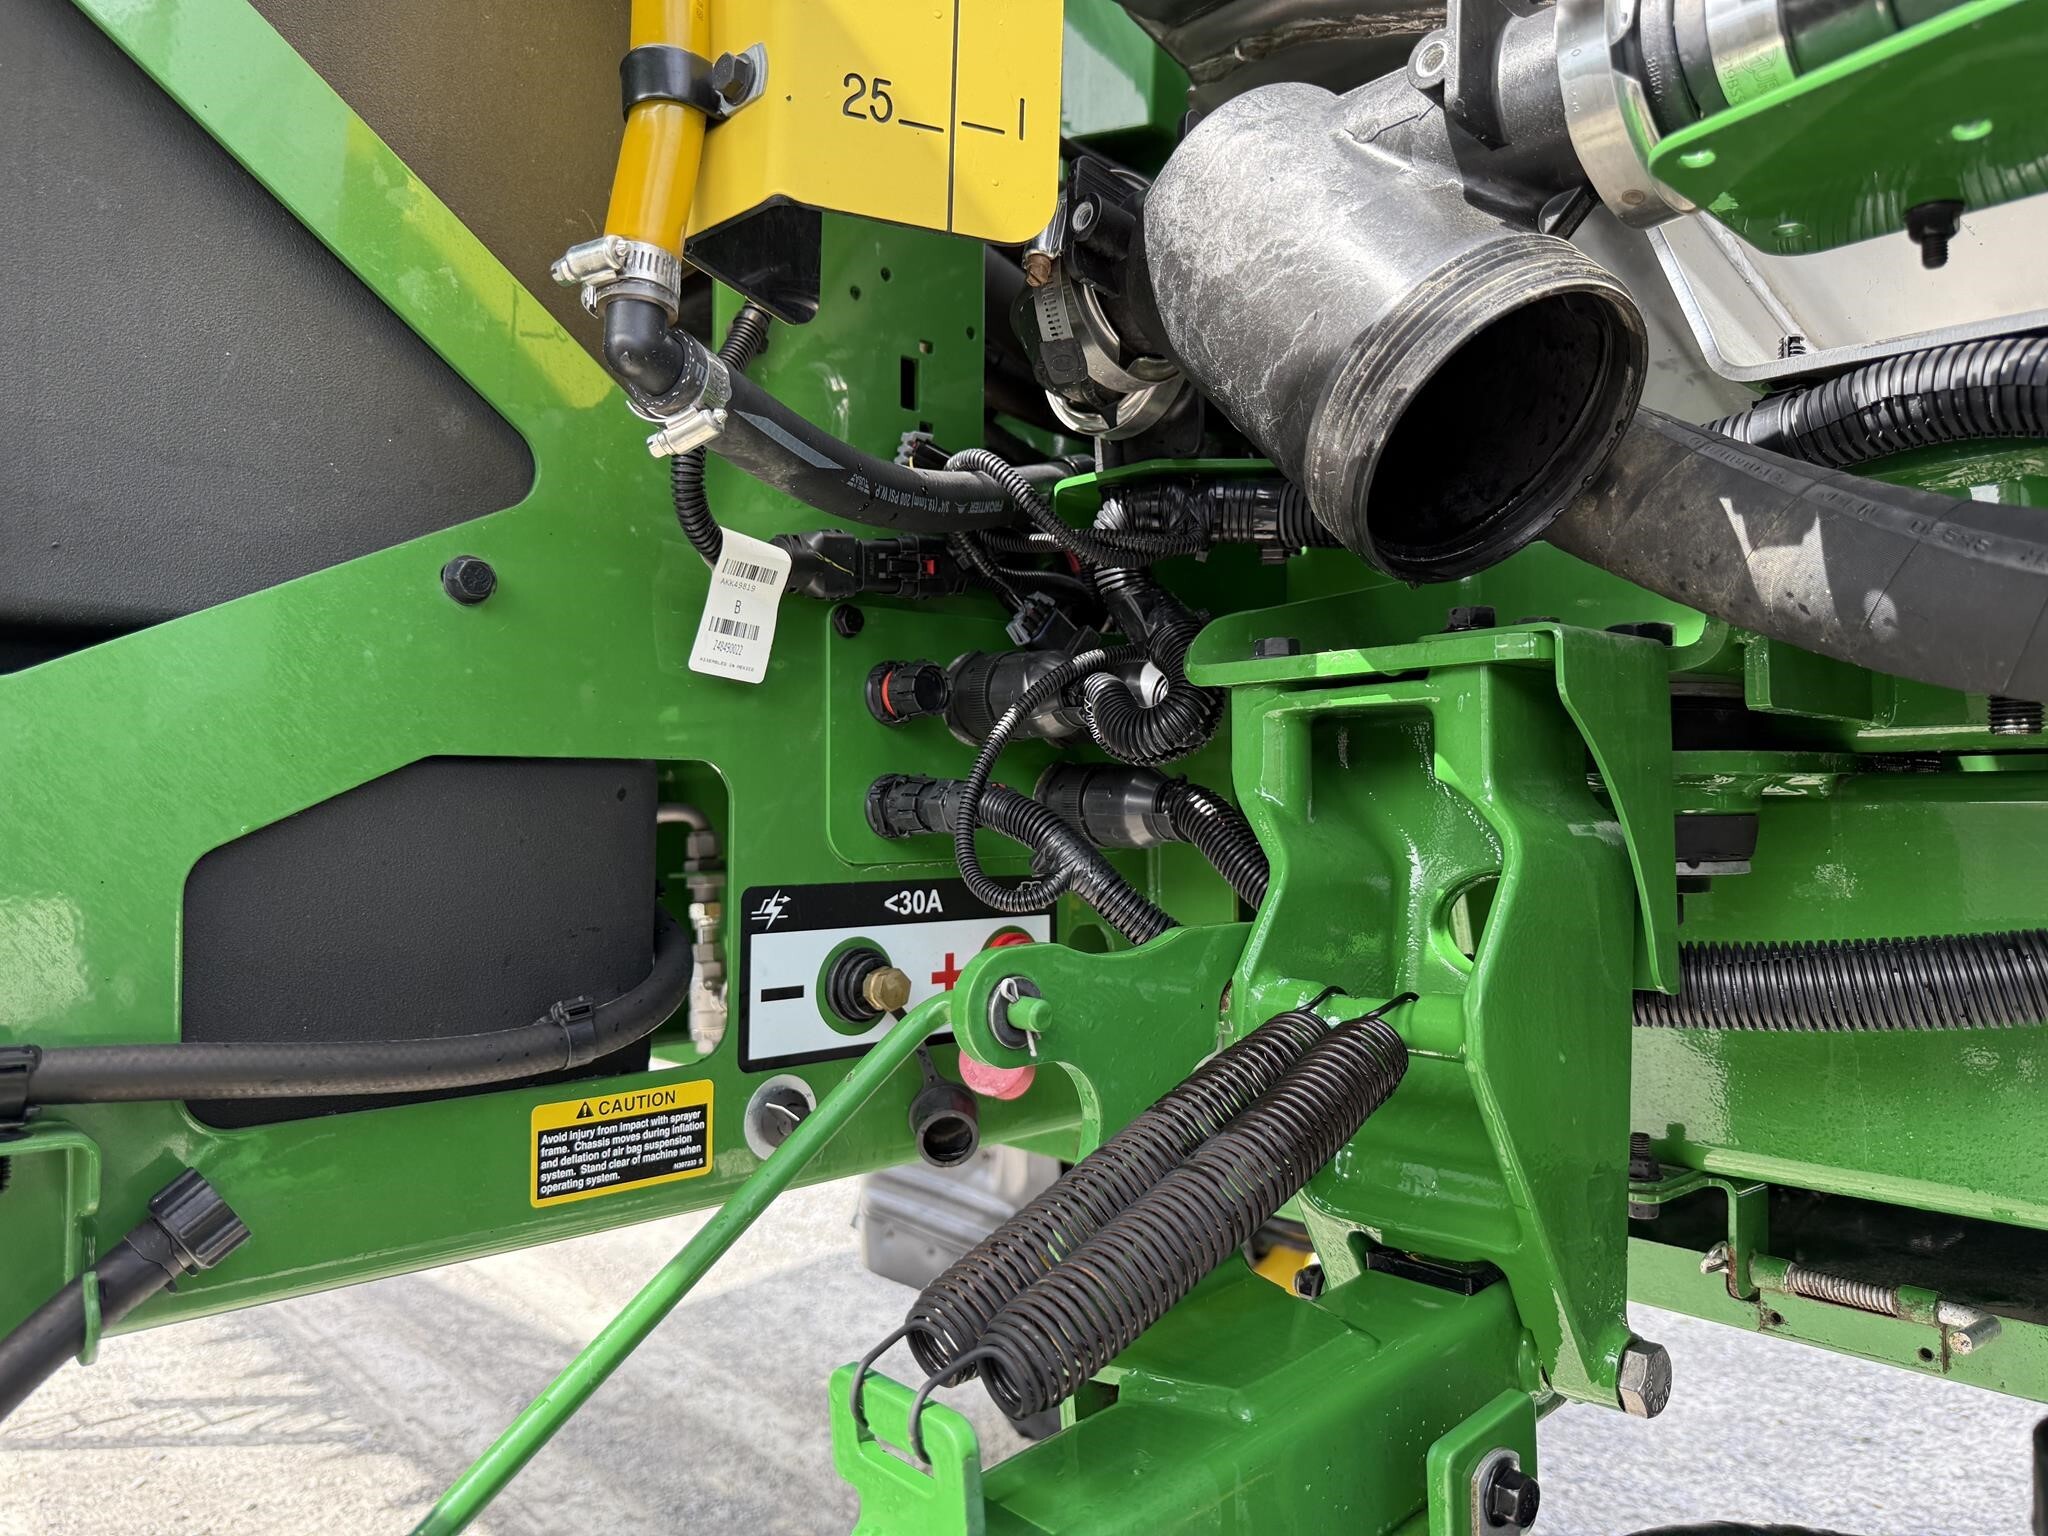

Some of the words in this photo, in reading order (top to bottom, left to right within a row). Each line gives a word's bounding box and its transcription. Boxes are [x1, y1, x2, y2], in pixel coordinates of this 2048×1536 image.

[842, 72, 893, 123] 25
[888, 488, 900, 505] PSI
[969, 500, 1004, 514] FRONTIER
[734, 599, 742, 614] B
[598, 1090, 676, 1115] CAUTION
[540, 1131, 568, 1145] Avoid
[569, 1128, 596, 1141] injury
[597, 1124, 618, 1136] from
[619, 1118, 649, 1132] impact
[650, 1114, 669, 1127] with
[670, 1110, 702, 1125] sprayer
[540, 1145, 570, 1158] frame.
[574, 1137, 611, 1151] Chassis
[612, 1132, 641, 1145] moves
[642, 1126, 671, 1139] during
[672, 1120, 705, 1134] inflation
[540, 1157, 559, 1170] and
[560, 1151, 600, 1166] deflation
[601, 1147, 612, 1158] of
[612, 1145, 625, 1157] air
[625, 1143, 643, 1155] bag
[643, 1134, 693, 1149] suspension
[540, 1168, 577, 1184] system.
[580, 1160, 607, 1175] Stand
[608, 1157, 631, 1170] clear
[631, 1154, 641, 1165] of
[642, 1148, 679, 1163] machine
[679, 1144, 702, 1156] when
[540, 1178, 584, 1195] operating
[585, 1171, 621, 1187] system.
